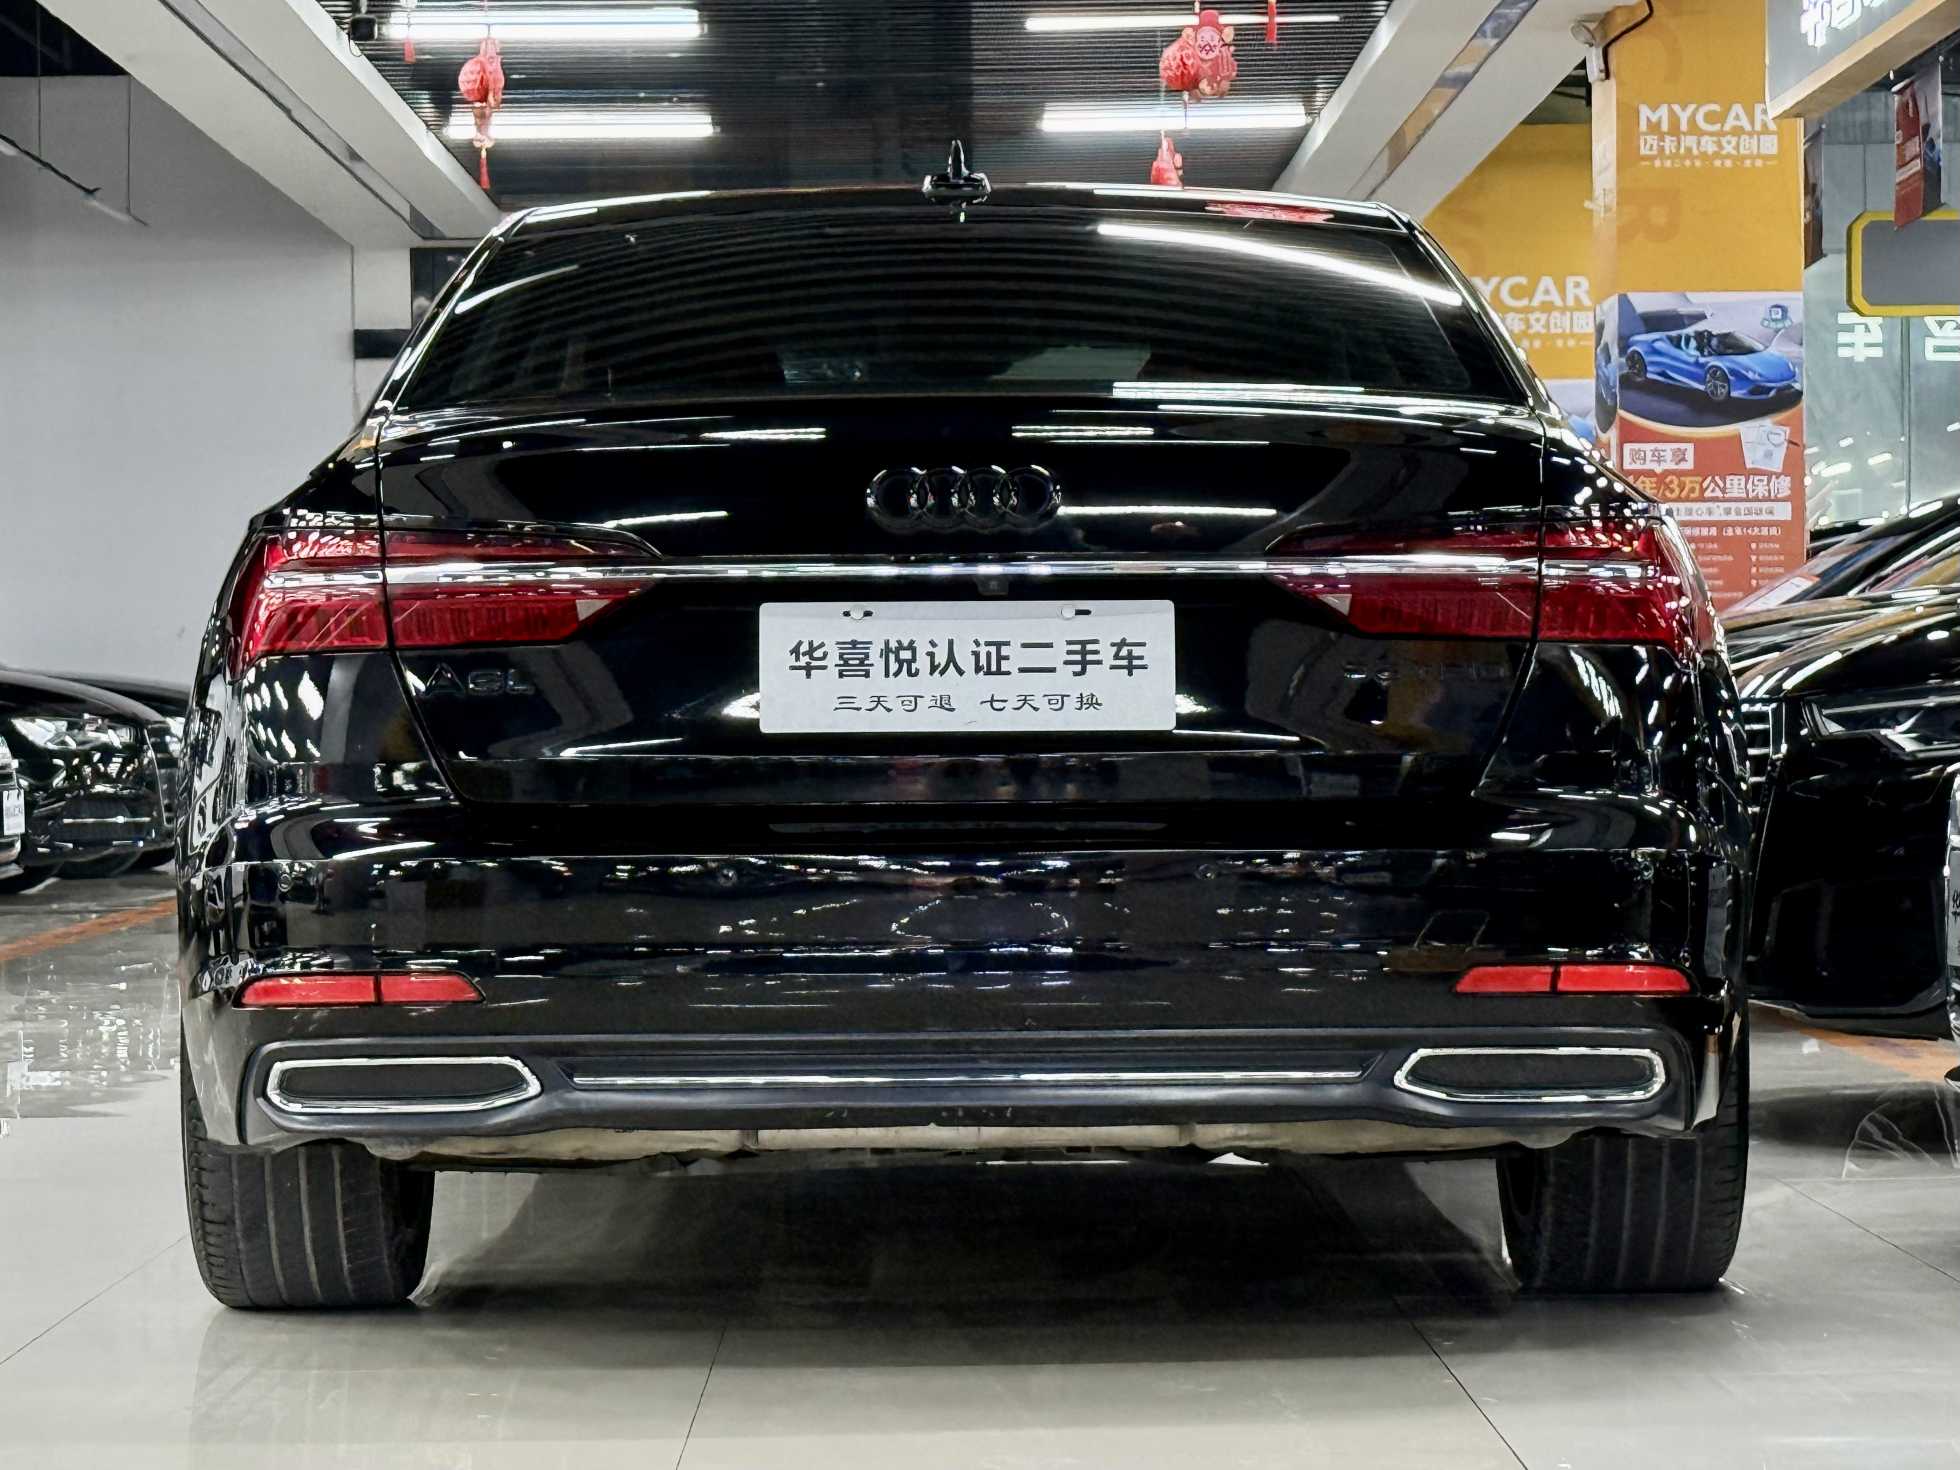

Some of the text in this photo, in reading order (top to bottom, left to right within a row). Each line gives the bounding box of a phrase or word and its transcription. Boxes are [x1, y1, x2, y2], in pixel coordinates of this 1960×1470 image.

[1639, 103, 1777, 132] MYCAR
[1628, 447, 1689, 466] 购车享
[1627, 475, 1792, 498] 年/3万公里保修
[788, 637, 1149, 679] 华喜悦认证二手车
[833, 693, 1103, 712] 三天可退 七天可换
